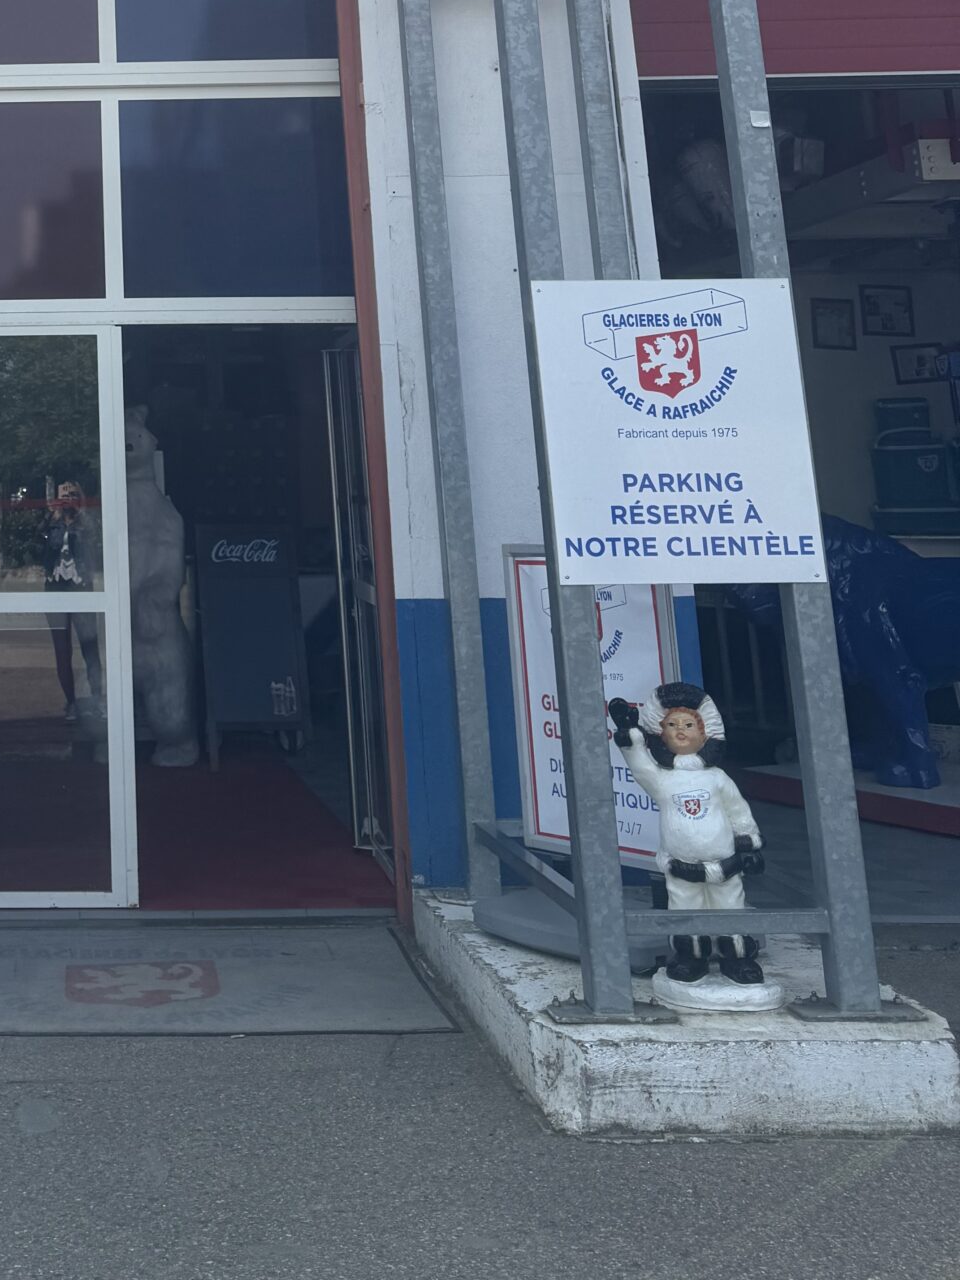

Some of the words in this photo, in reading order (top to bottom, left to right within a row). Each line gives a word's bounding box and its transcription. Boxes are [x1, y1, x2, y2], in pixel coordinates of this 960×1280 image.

[603, 313, 670, 327] GLACIERES
[674, 314, 687, 327] de
[691, 312, 722, 327] LYON
[601, 367, 644, 412] GLACE
[646, 403, 658, 418] A
[662, 366, 738, 420] RAFRAICHIR
[617, 428, 669, 439] Fabricant
[672, 428, 708, 441] depuis
[711, 428, 738, 438] 1975
[622, 472, 743, 493] PARKING
[611, 499, 734, 525] RÉSERVÉ
[743, 498, 763, 524] À
[211, 539, 280, 562] Coca-Cola
[565, 537, 659, 557] NOTRE
[667, 531, 816, 556] CLIENTÈLE
[596, 590, 612, 601] LYON
[609, 673, 624, 681] 1975
